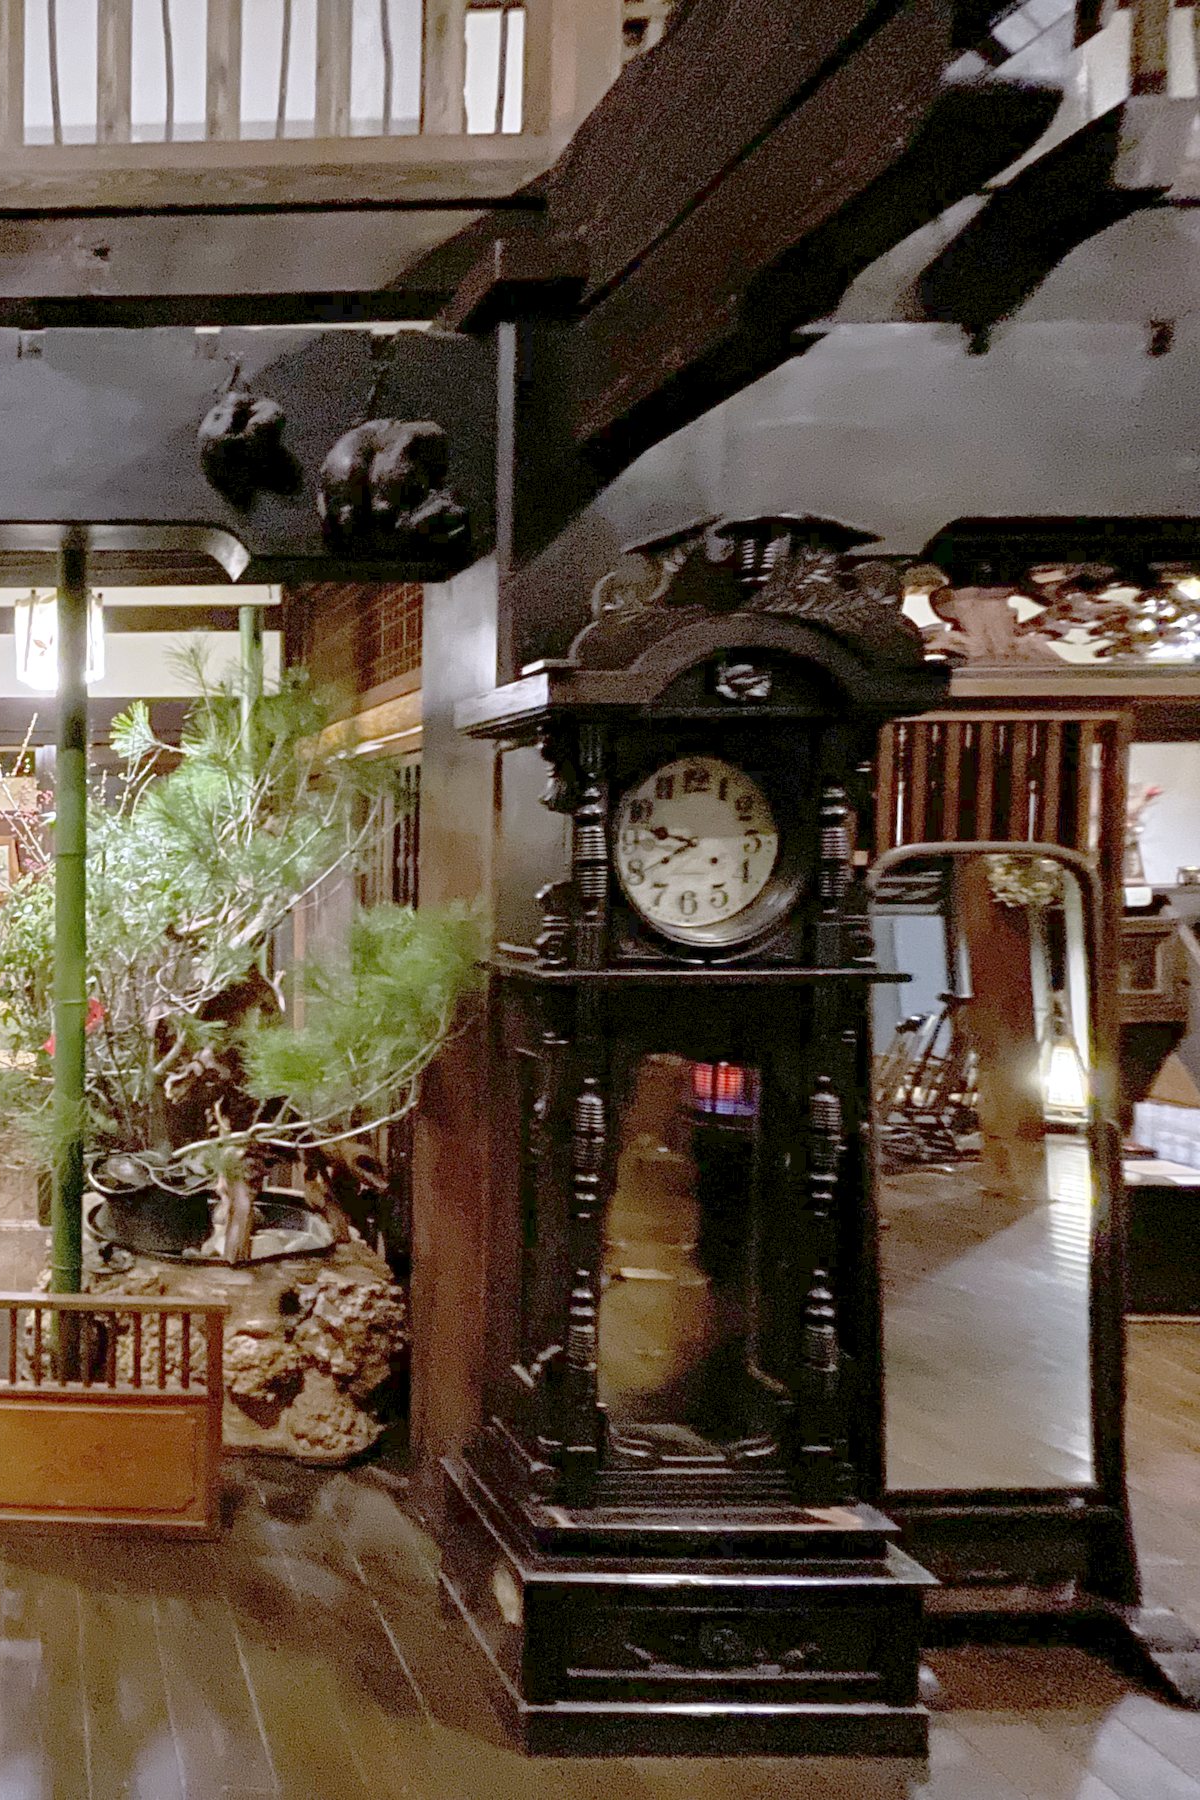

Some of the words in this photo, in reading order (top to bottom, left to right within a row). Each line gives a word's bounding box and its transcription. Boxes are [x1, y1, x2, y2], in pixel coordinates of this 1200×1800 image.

[655, 775, 674, 800] 11
[682, 767, 711, 793] 12
[718, 777, 729, 801] 1
[735, 795, 754, 821] 2
[622, 827, 639, 855] 9
[743, 829, 763, 854] 3
[626, 859, 645, 886] 8
[651, 883, 669, 907] 7
[678, 890, 698, 916] 6
[710, 883, 729, 909] 5
